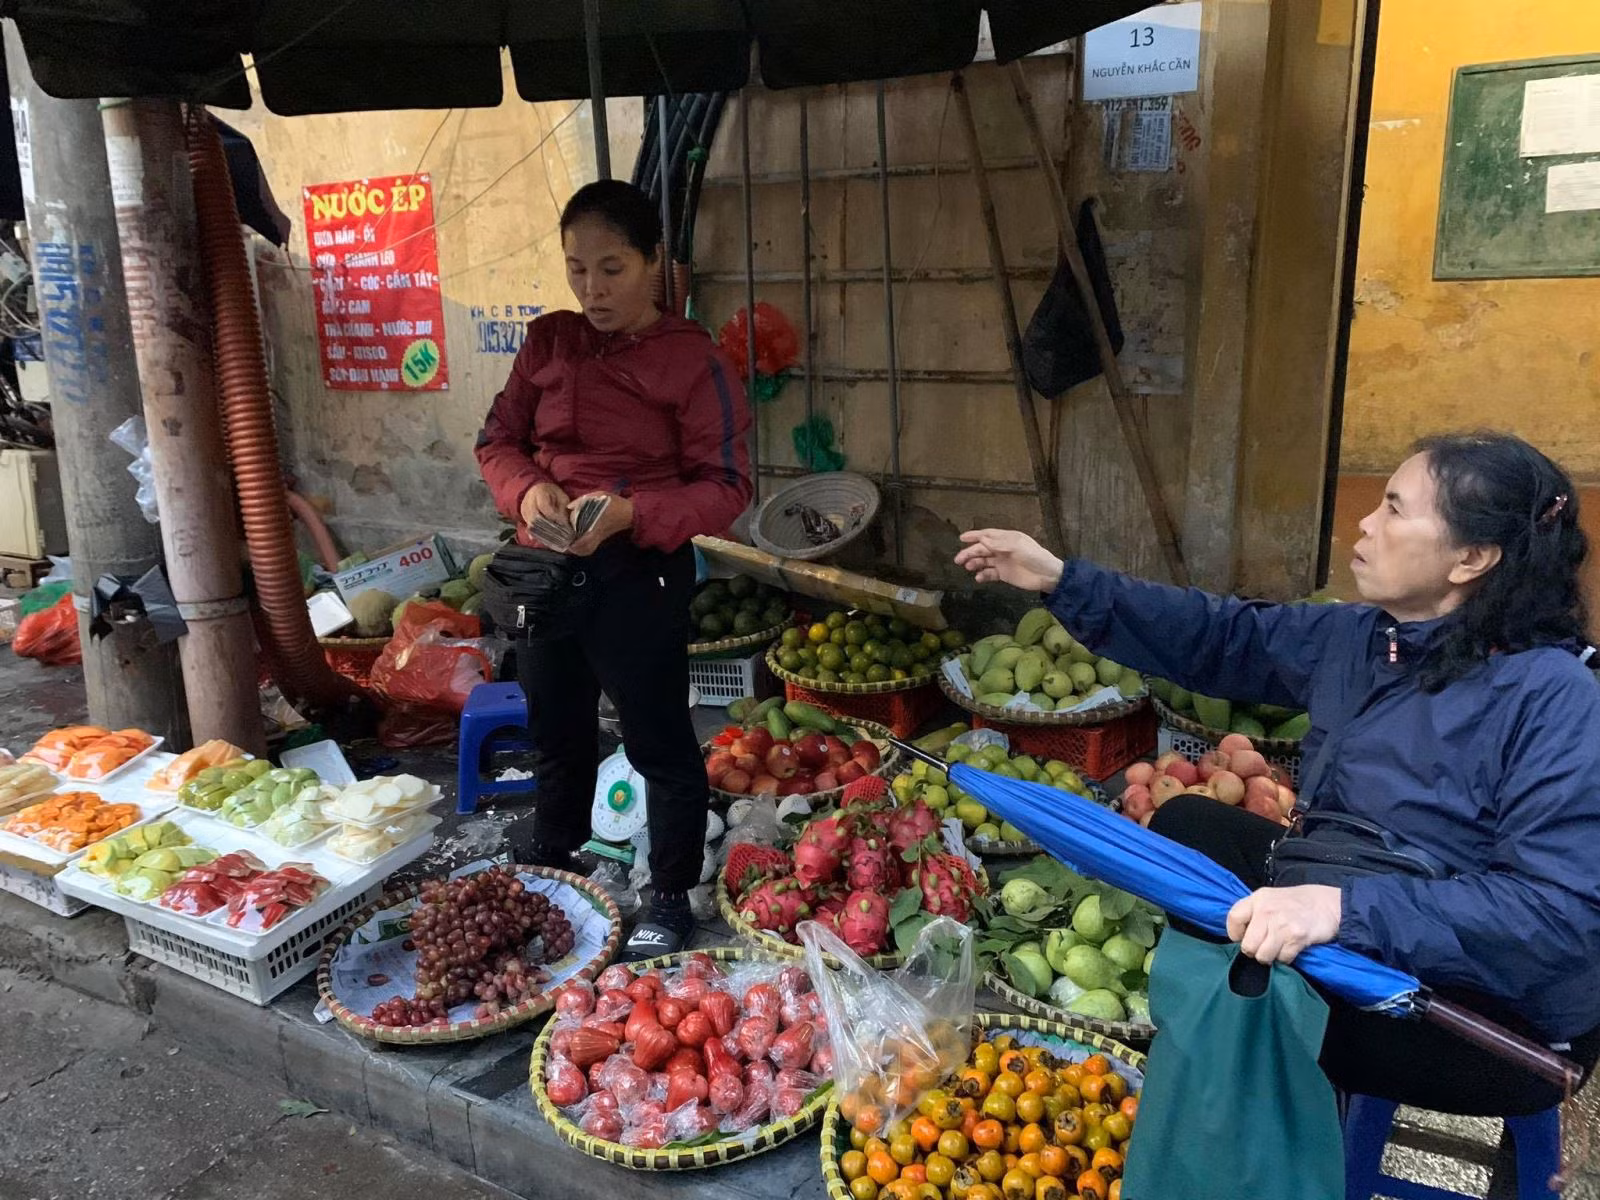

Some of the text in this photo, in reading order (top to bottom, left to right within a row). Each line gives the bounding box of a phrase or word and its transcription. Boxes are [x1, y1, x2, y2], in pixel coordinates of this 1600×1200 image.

[1129, 26, 1155, 48] 13
[1092, 62, 1135, 78] NGUYỄN
[1138, 60, 1166, 74] KHẮC
[311, 178, 426, 222] NƯỚC ÉP
[490, 305, 499, 317] C
[505, 305, 513, 317] B
[404, 342, 437, 381] 15K
[399, 547, 433, 567] 400
[635, 929, 664, 943] NIKE
